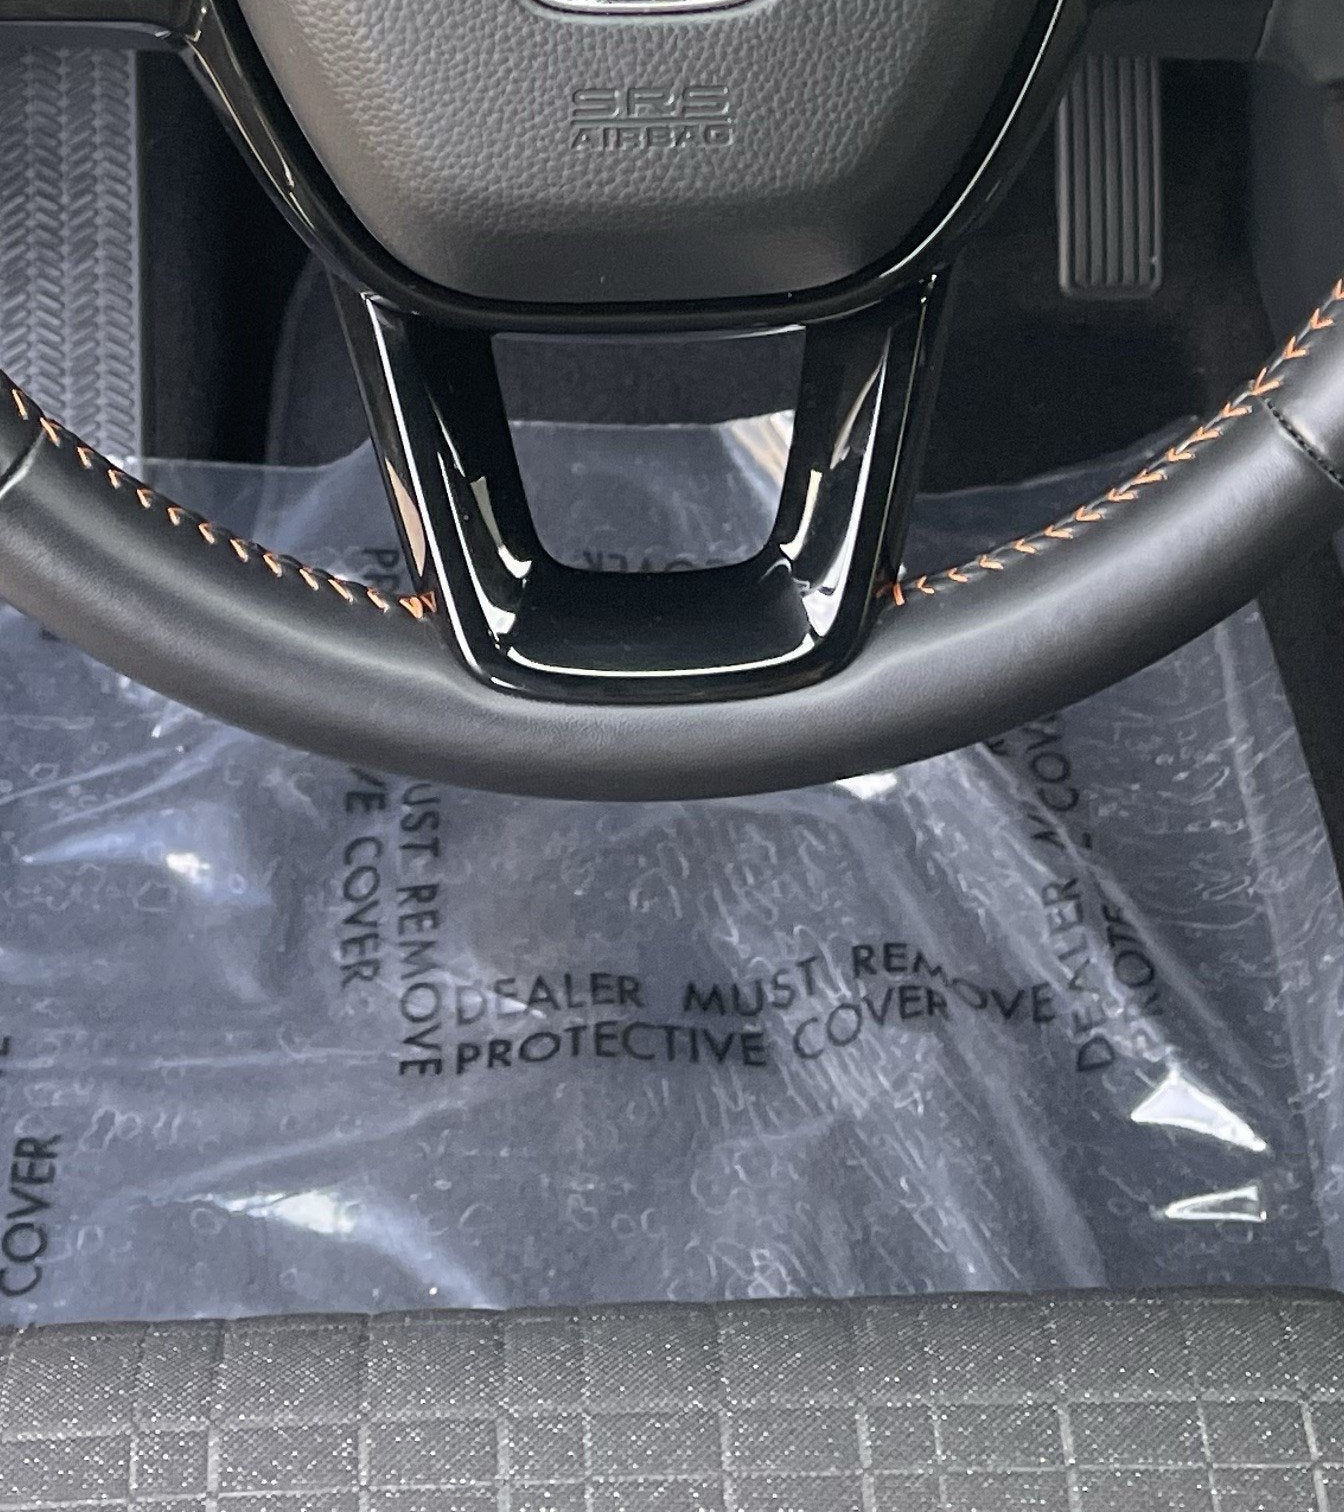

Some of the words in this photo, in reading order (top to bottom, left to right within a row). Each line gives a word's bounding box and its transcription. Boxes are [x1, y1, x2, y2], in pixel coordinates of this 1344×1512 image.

[570, 125, 735, 150] AIRBAG
[572, 87, 730, 119] SRS
[340, 835, 384, 988] COVER
[396, 883, 442, 1077] REMOVE
[457, 973, 645, 1025] DEALER
[683, 955, 822, 1017] MUST
[457, 1020, 768, 1075] PROTECTIVE
[793, 984, 950, 1061] COVER
